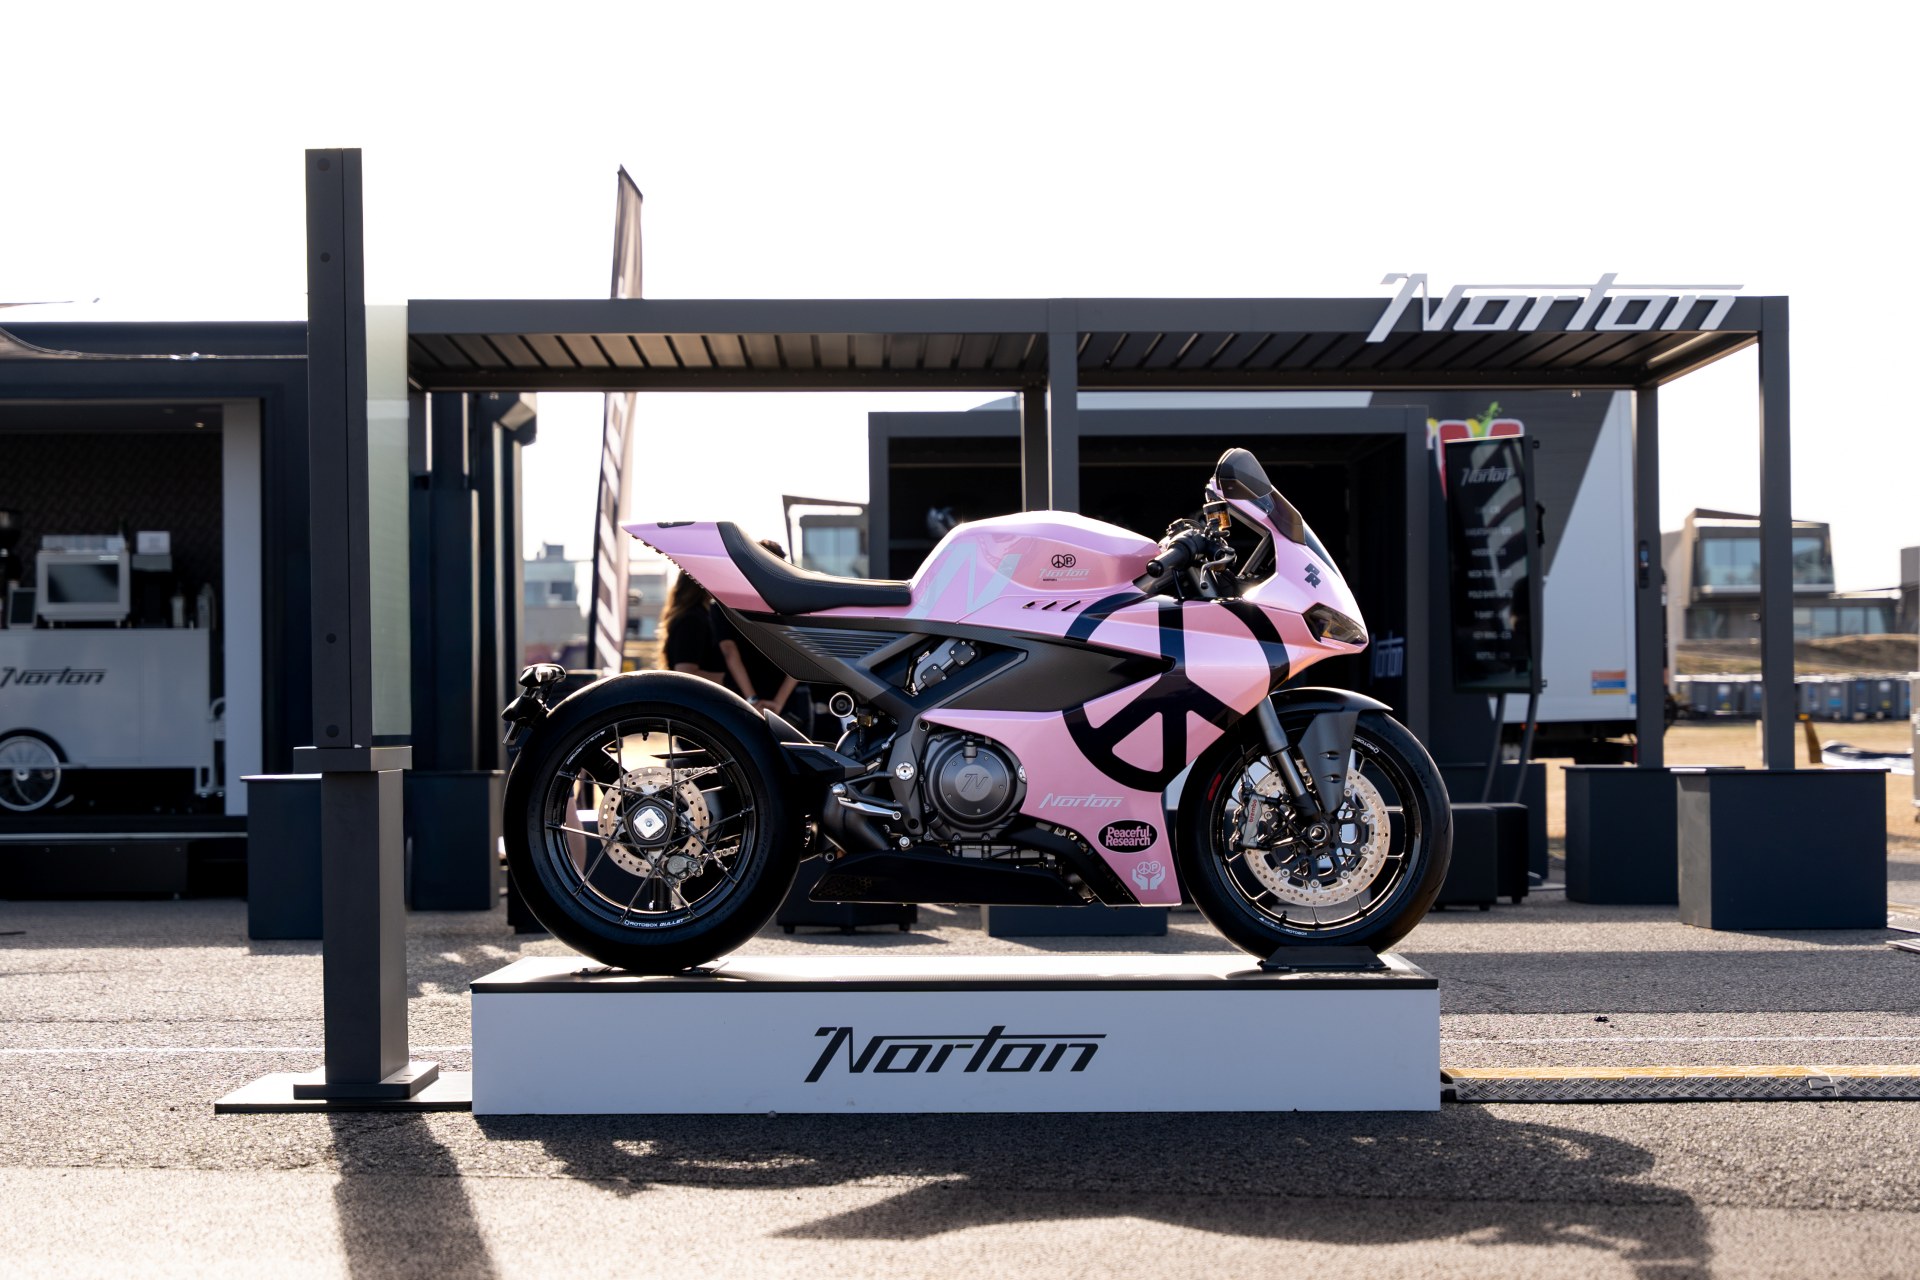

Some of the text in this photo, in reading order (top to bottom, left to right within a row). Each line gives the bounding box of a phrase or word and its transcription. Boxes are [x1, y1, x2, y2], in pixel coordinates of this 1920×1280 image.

[1366, 273, 1744, 343] Norton
[1461, 466, 1512, 487] Norton
[1040, 568, 1088, 578] Norton
[0, 666, 108, 688] Norton
[1038, 792, 1124, 808] Norton
[1249, 799, 1258, 823] brembo
[1105, 835, 1151, 846] Research
[1107, 825, 1151, 838] Peaceful
[804, 1025, 1107, 1083] Norton
